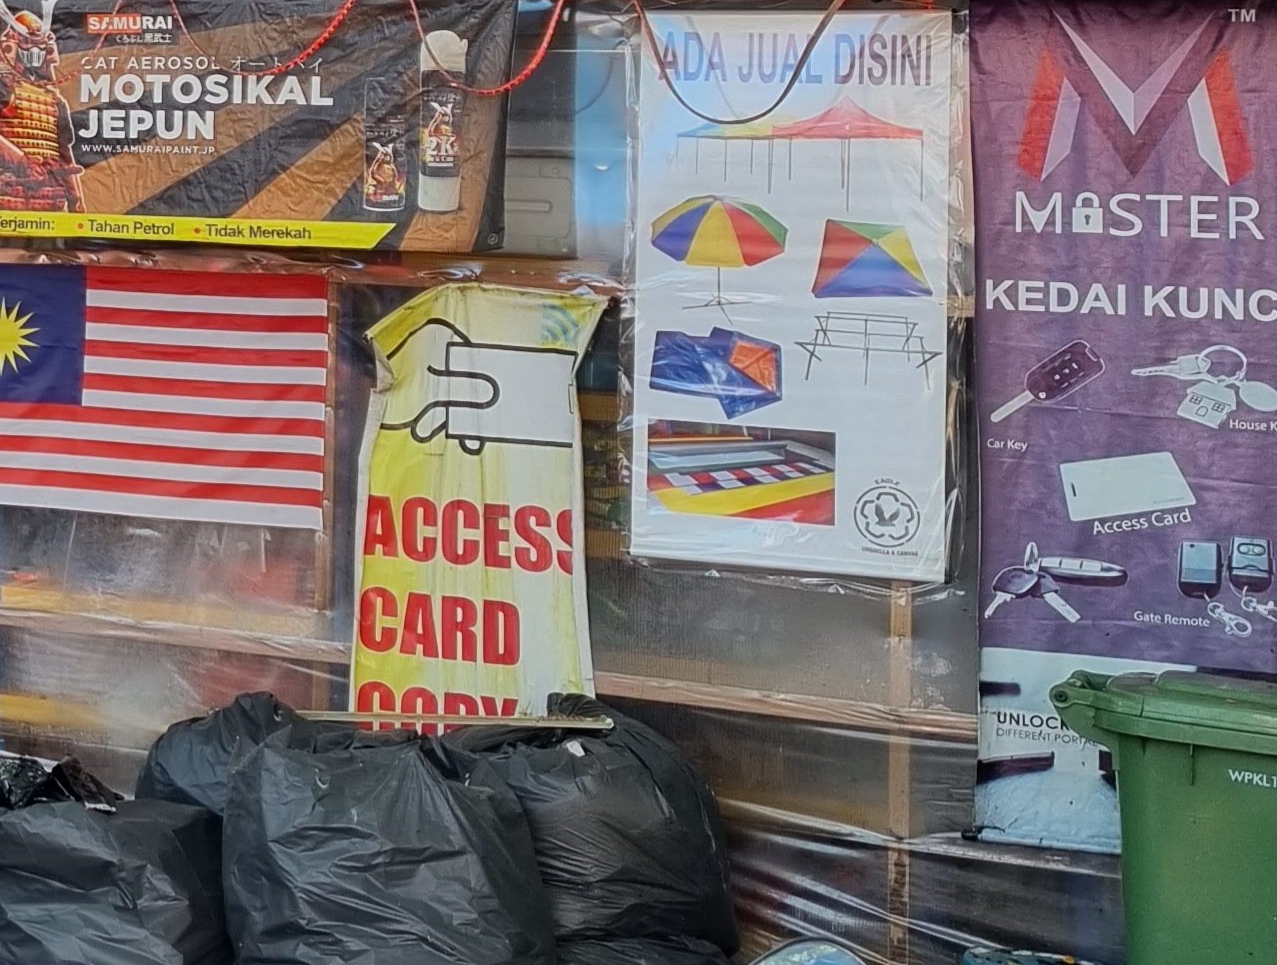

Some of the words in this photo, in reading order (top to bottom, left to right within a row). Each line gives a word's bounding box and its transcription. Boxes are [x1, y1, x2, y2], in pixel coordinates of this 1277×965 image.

[88, 15, 173, 30] SAMURAI
[81, 56, 118, 70] CAT
[127, 56, 221, 71] AEROSOL
[658, 31, 728, 82] ADA
[738, 33, 824, 84] JUAL
[834, 34, 933, 86] DISINI
[80, 73, 334, 106] MOTOSIKAL
[78, 109, 215, 140] JEPUN
[81, 143, 216, 155] WWW.SAMURAIPAINT.JP
[88, 219, 130, 234] Tahan
[133, 221, 175, 236] Petrol
[205, 223, 245, 238] Tidak
[249, 226, 312, 240] Merekah
[985, 279, 1126, 316] KEDAI
[1144, 285, 1277, 322] KUNC
[1229, 418, 1268, 431] House
[987, 438, 1005, 450] Car
[1007, 438, 1028, 452] Key
[1092, 517, 1149, 535] Access
[1151, 507, 1192, 528] Card
[359, 586, 521, 666] CARD
[1134, 610, 1162, 624] Gate
[1164, 612, 1211, 628] Remote
[357, 681, 520, 736] CO
[996, 727, 1050, 742] DIFFERENT
